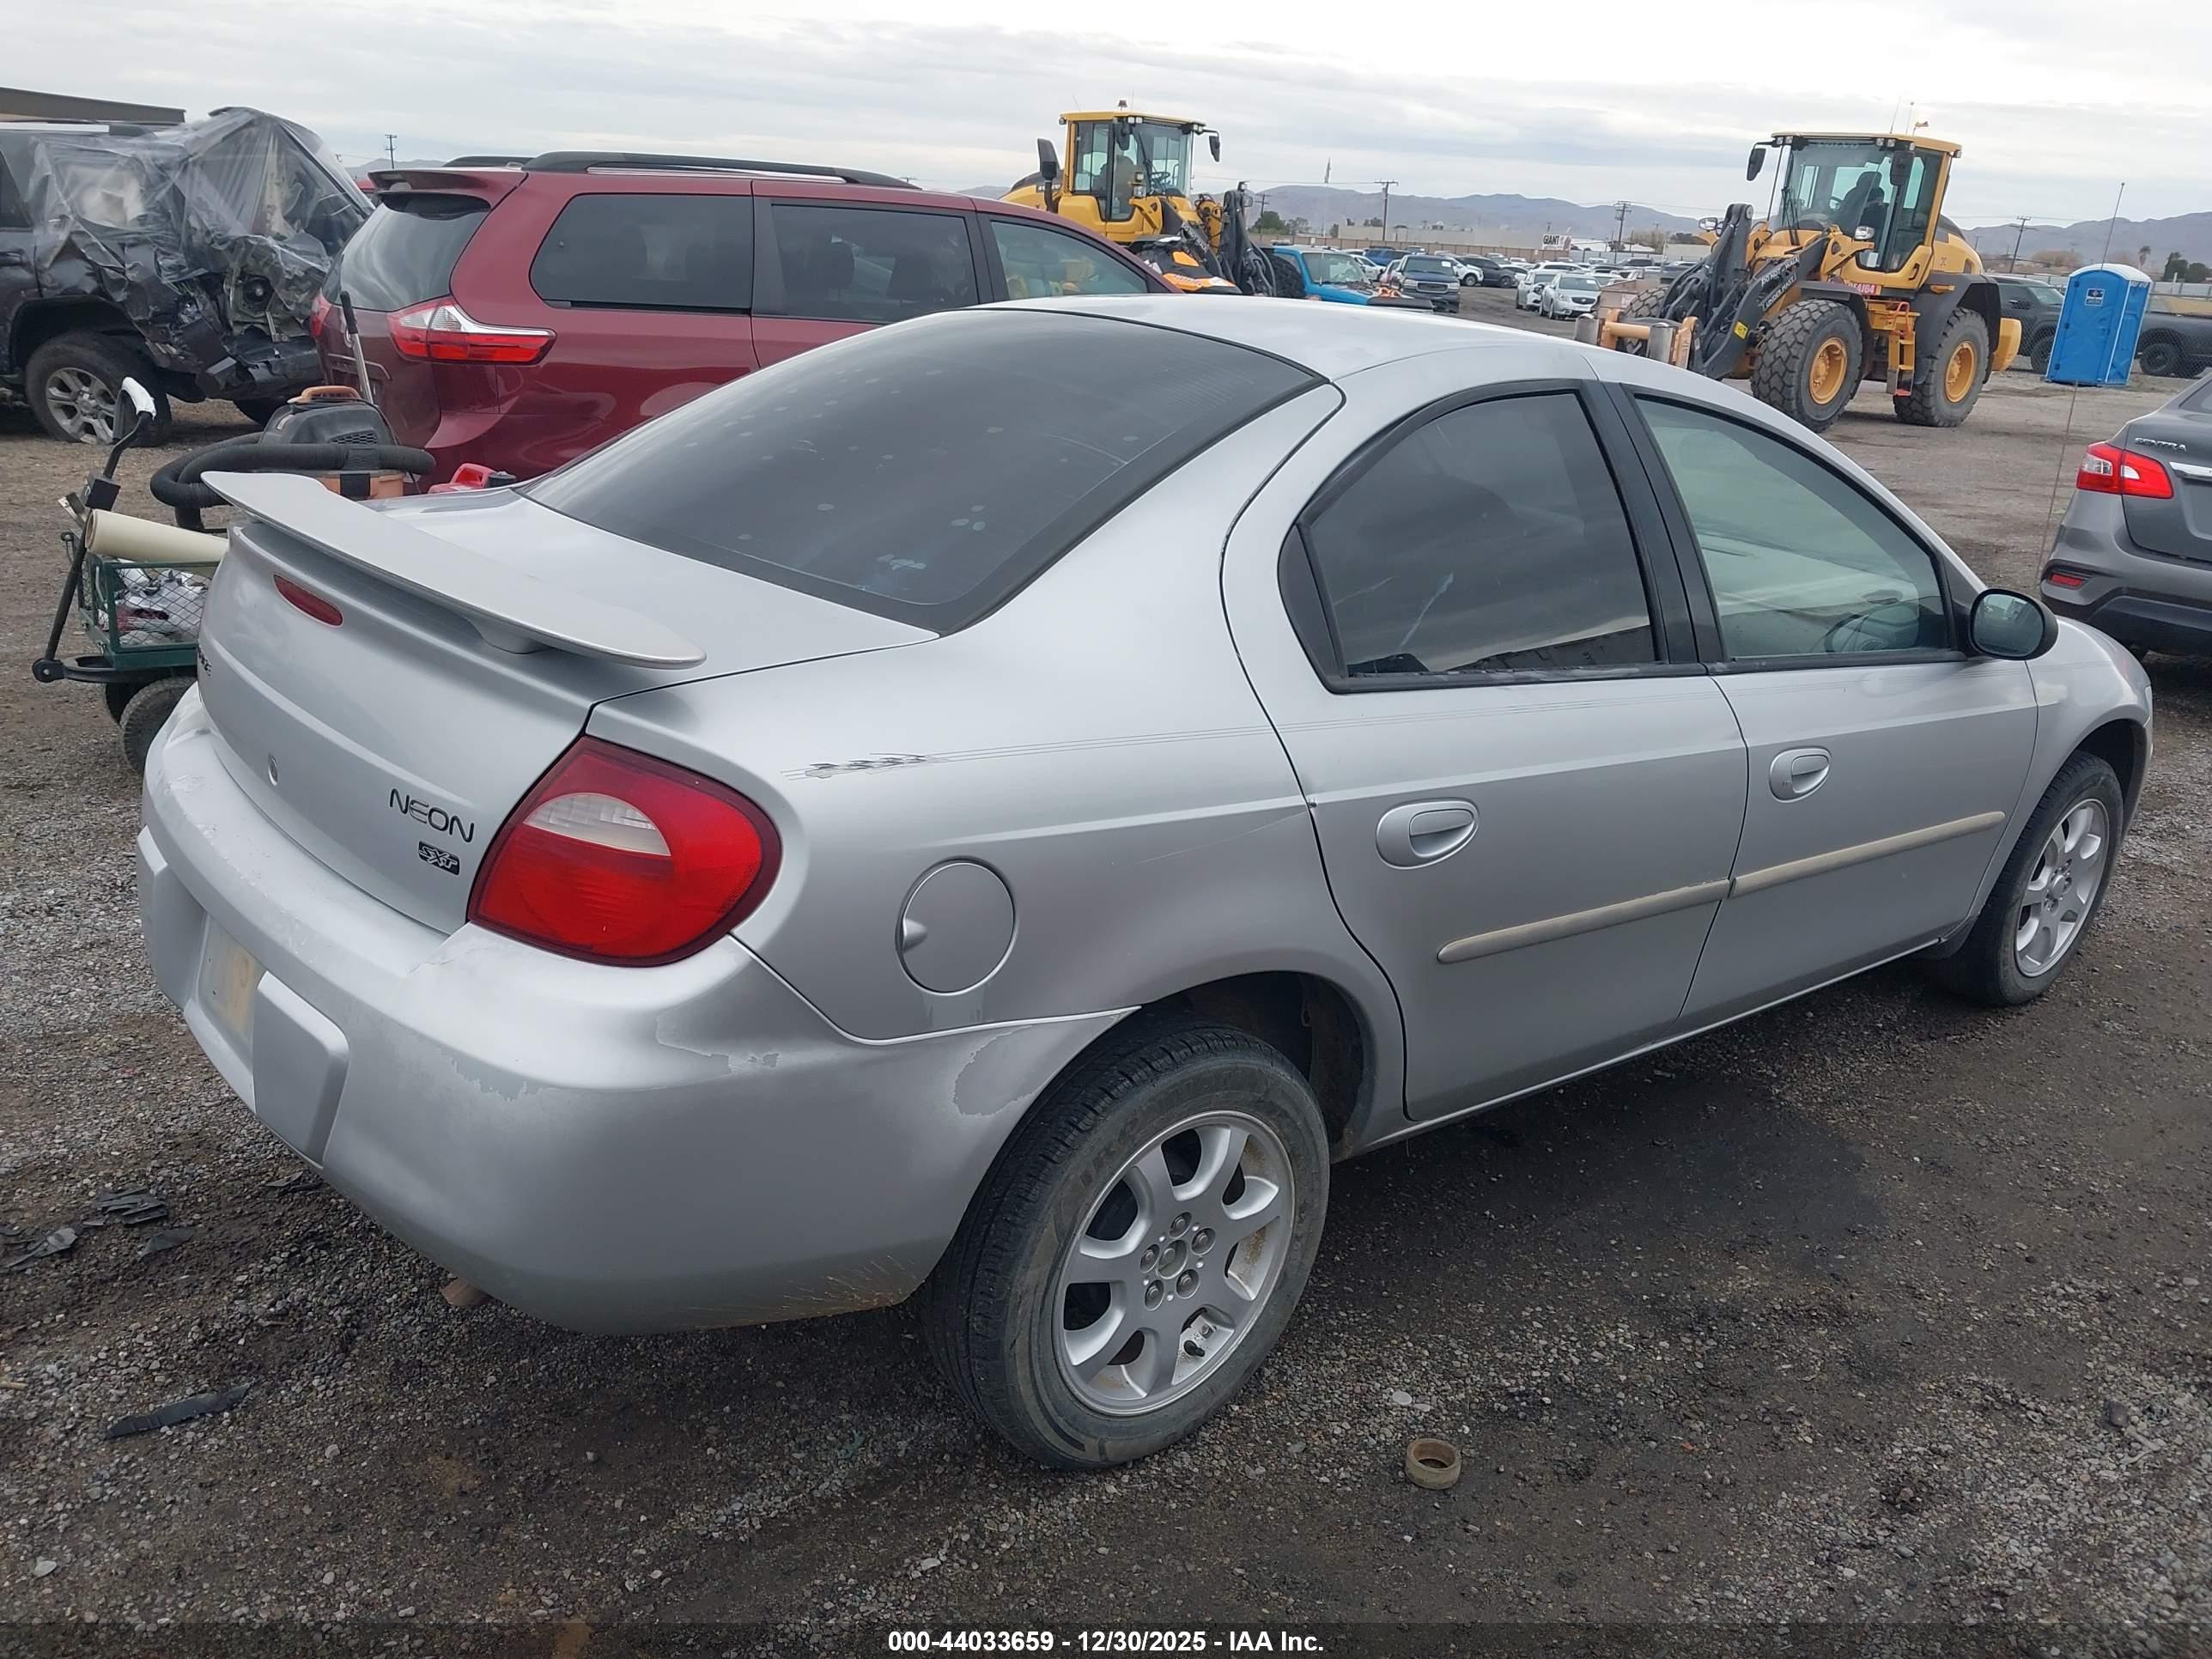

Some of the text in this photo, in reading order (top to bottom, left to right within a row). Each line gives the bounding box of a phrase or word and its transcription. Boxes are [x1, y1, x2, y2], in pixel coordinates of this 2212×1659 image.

[1543, 234, 1560, 246] GIANT
[2135, 437, 2187, 453] SENTRA
[389, 788, 475, 843] NEON
[418, 844, 459, 870] SXT
